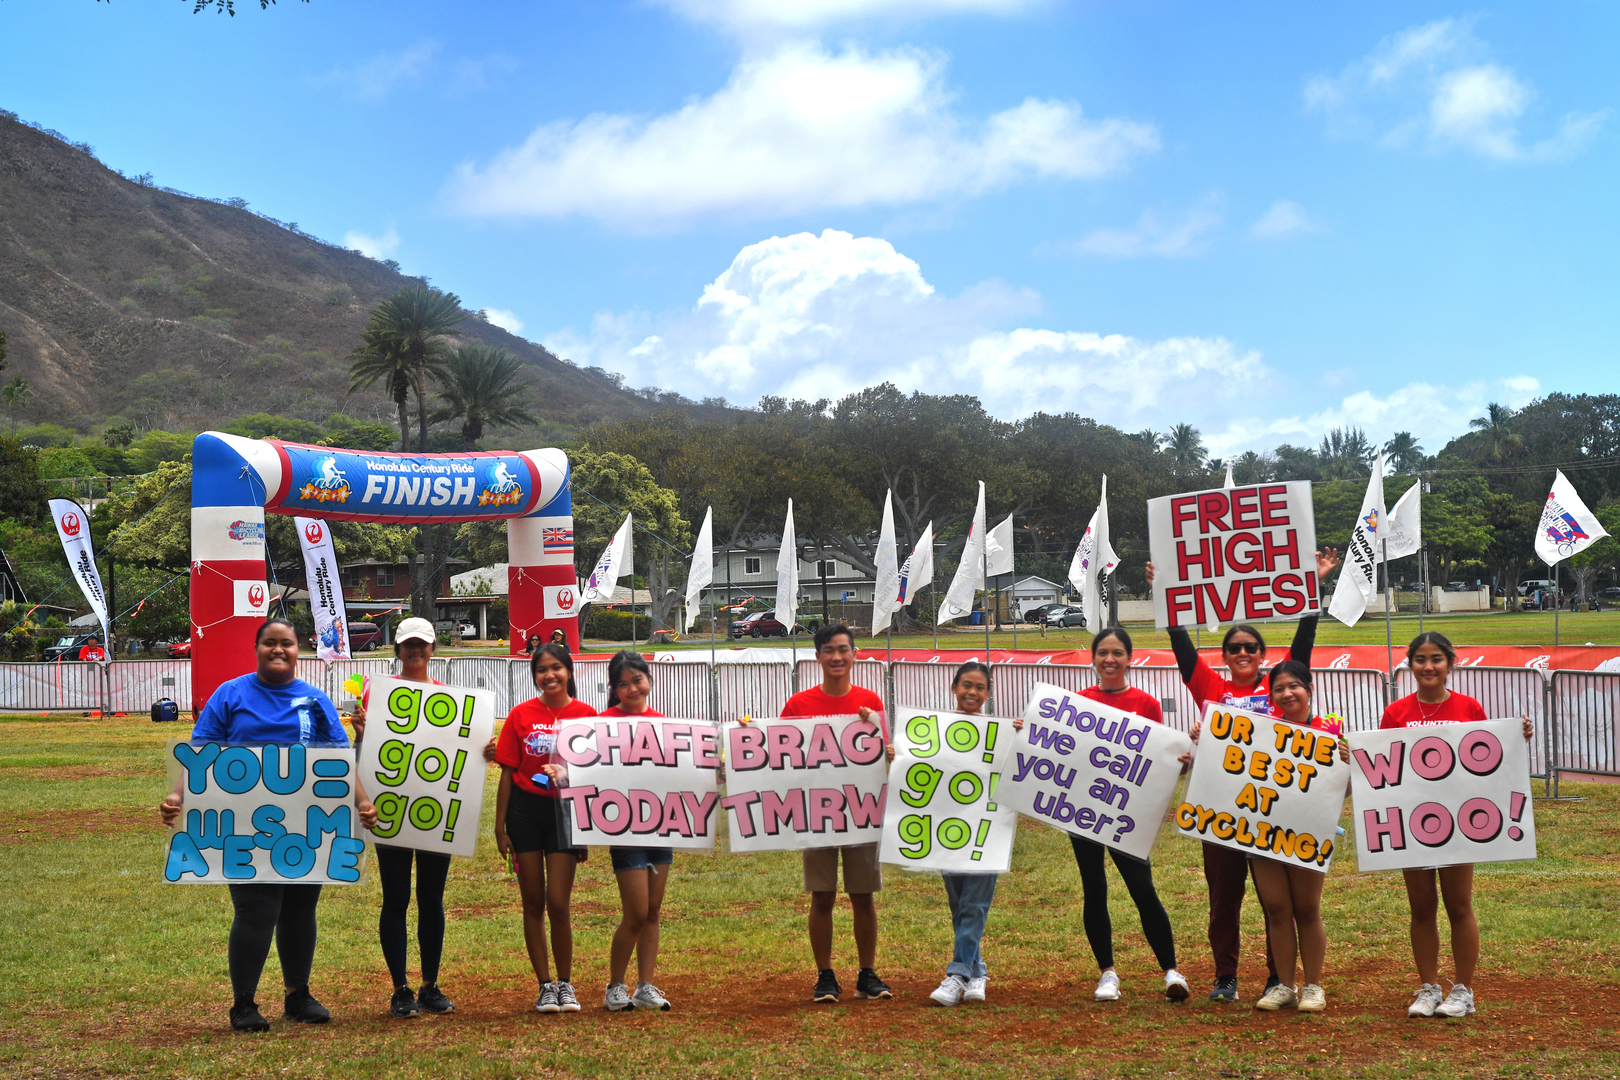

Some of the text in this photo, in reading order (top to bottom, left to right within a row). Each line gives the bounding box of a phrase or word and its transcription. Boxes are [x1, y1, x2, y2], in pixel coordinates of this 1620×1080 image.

[361, 474, 476, 506] FINISH
[366, 461, 475, 475] Honolulu Century Ride
[1171, 485, 1290, 538] FREE
[76, 561, 99, 602] Honolulu
[80, 550, 92, 572] Ride
[1176, 529, 1300, 581] HIGH
[315, 567, 328, 608] Honolulu
[320, 557, 336, 616] Century Ride
[1165, 571, 1319, 627] FIVES!
[386, 687, 475, 738] go!
[905, 714, 999, 764] go!
[1038, 695, 1151, 753] should
[1210, 710, 1337, 767] UR THE
[375, 739, 467, 793] go!
[556, 721, 721, 769] CHAFE
[729, 719, 884, 772] BRAG
[1028, 723, 1153, 787] we call
[1222, 745, 1318, 793] BEST
[1351, 729, 1504, 790] WOO
[900, 762, 1000, 811] go!
[1012, 752, 1130, 811] you an
[1235, 783, 1279, 816] AT
[370, 791, 461, 842] go!
[560, 784, 721, 838] TODAY
[720, 783, 888, 838] TMRW
[1033, 790, 1136, 843] uber?
[1176, 802, 1334, 867] CYCLING!
[1363, 790, 1527, 853] HOO!
[898, 814, 991, 861] go!
